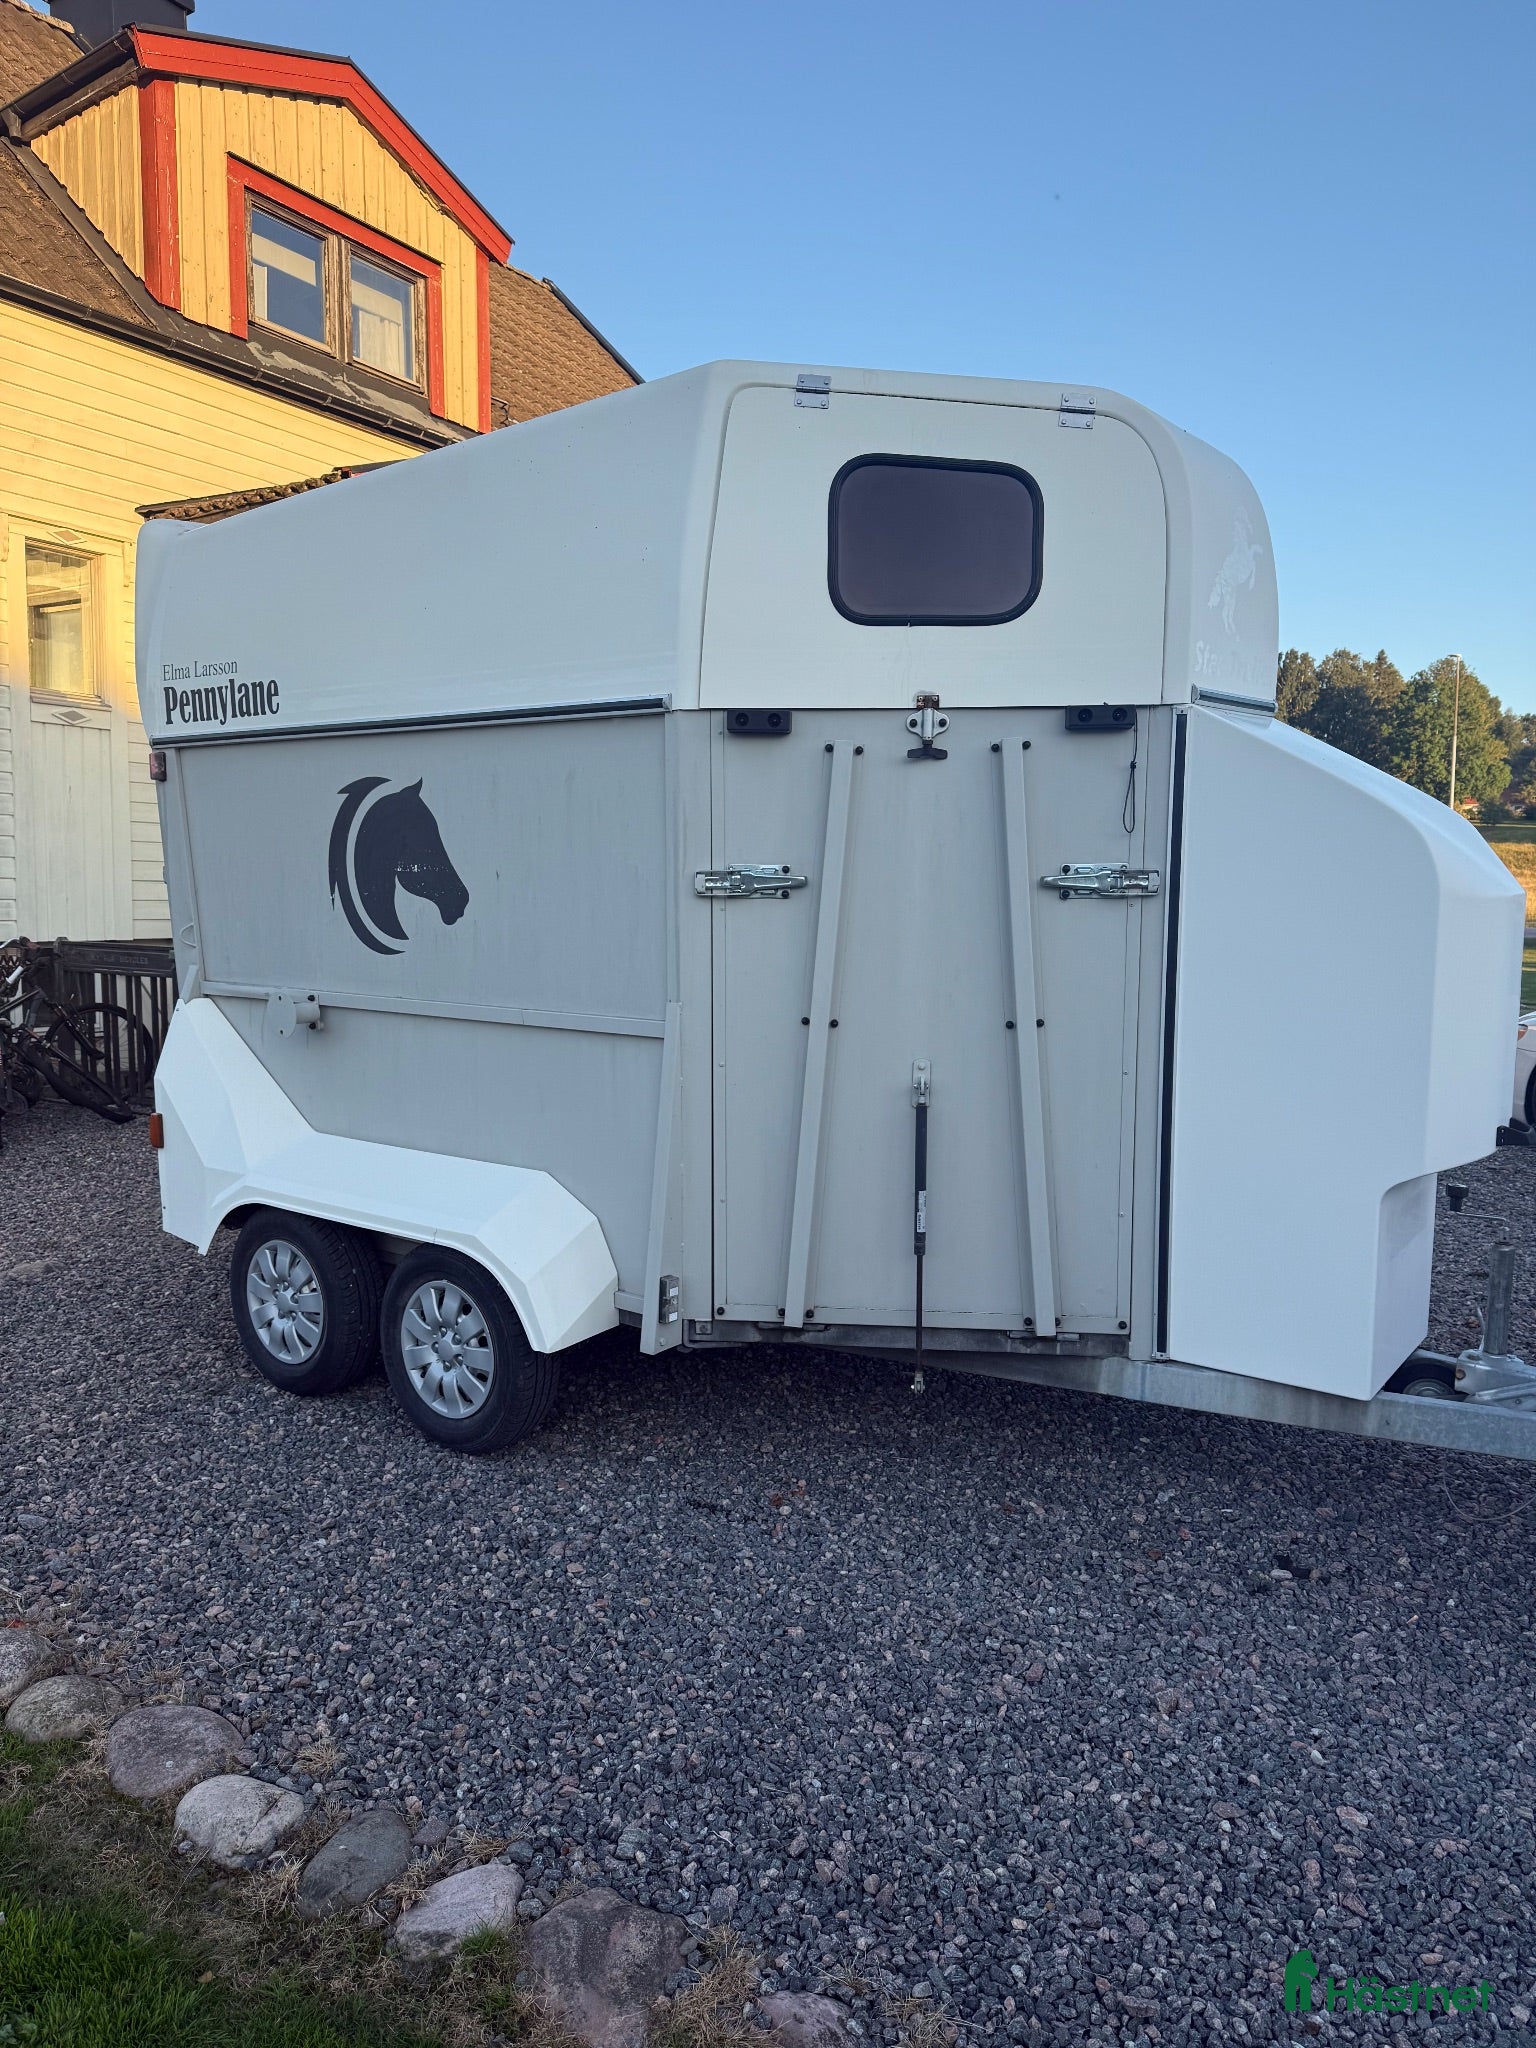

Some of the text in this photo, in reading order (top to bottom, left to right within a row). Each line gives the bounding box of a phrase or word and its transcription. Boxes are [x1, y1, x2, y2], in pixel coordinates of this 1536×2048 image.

[163, 660, 238, 681] Elma Larsson
[163, 679, 280, 726] Pennylane
